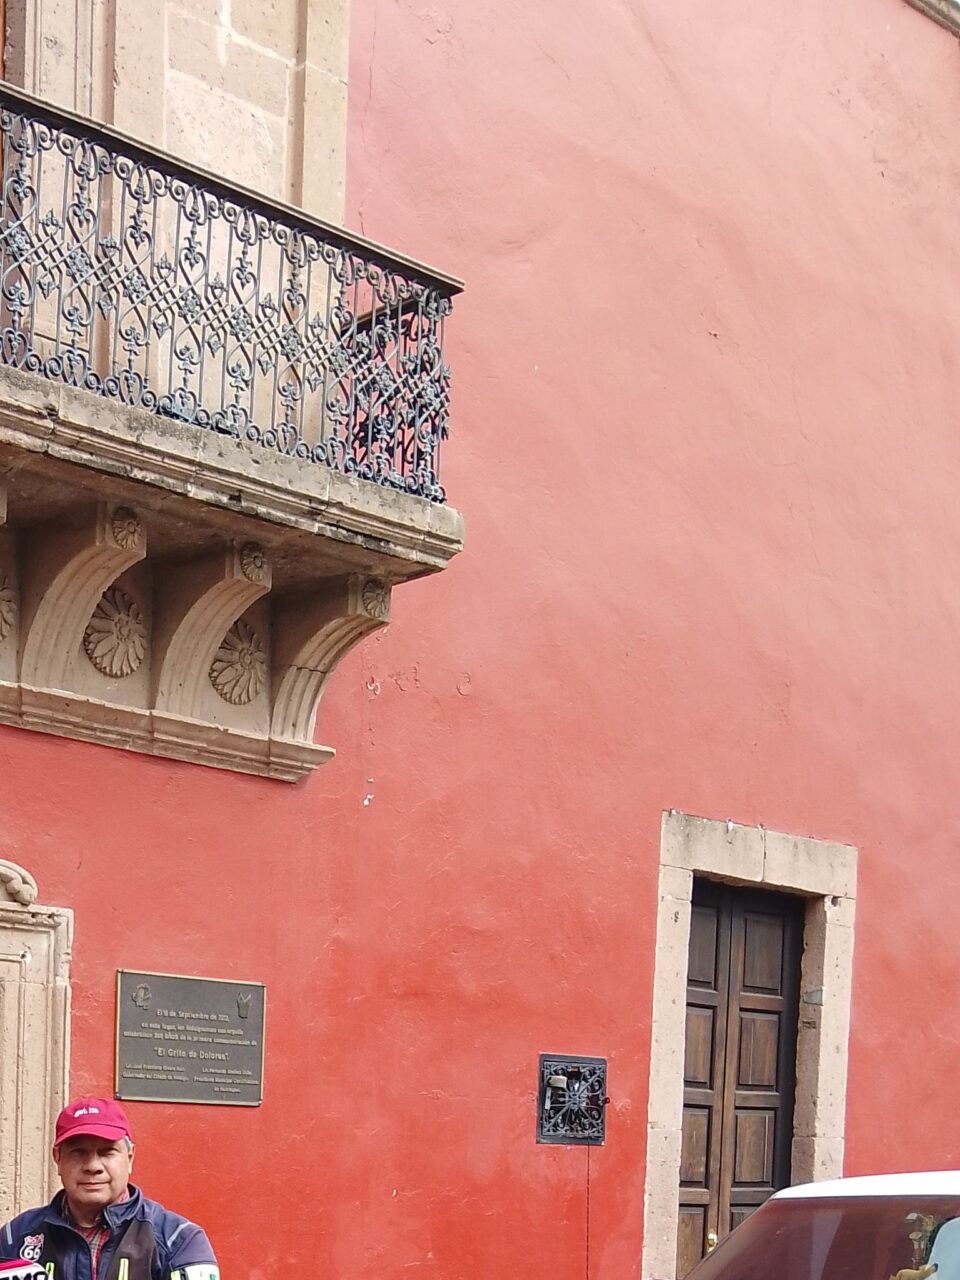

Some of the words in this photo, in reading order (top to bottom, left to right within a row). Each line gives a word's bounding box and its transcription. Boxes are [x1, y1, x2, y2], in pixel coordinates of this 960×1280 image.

[168, 1048, 186, 1057] Grito
[188, 1050, 197, 1058] de
[24, 1246, 41, 1259] 66
